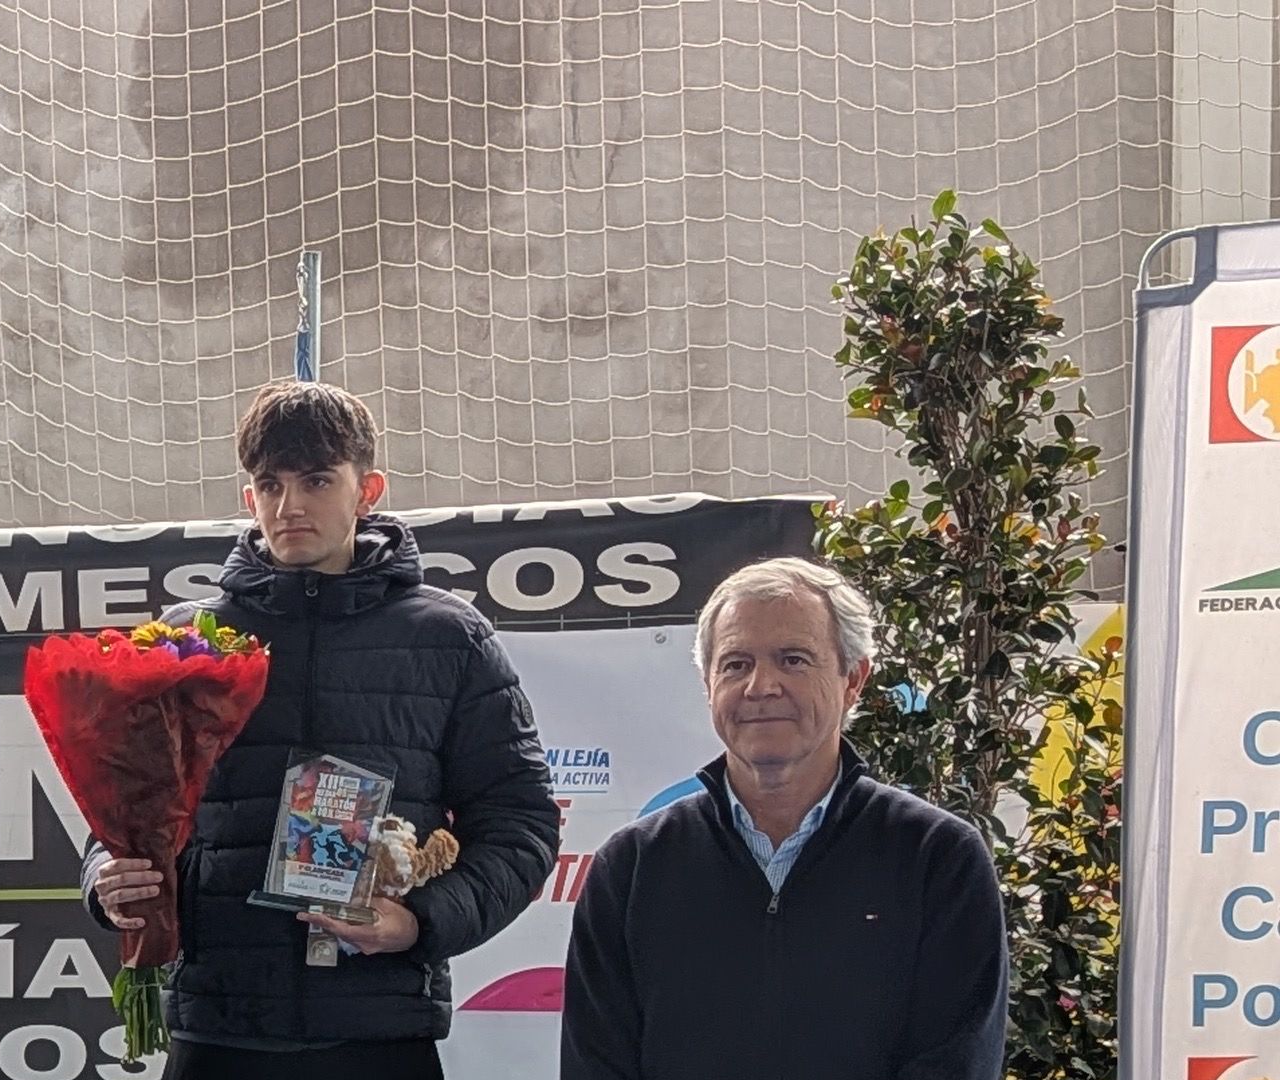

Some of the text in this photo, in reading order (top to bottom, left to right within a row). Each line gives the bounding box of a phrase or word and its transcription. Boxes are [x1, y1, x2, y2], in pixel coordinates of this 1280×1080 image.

[562, 748, 610, 768] LEJÍA
[562, 772, 610, 785] ACTIVA
[1200, 801, 1280, 854] Pr
[1192, 974, 1280, 1027] Po
